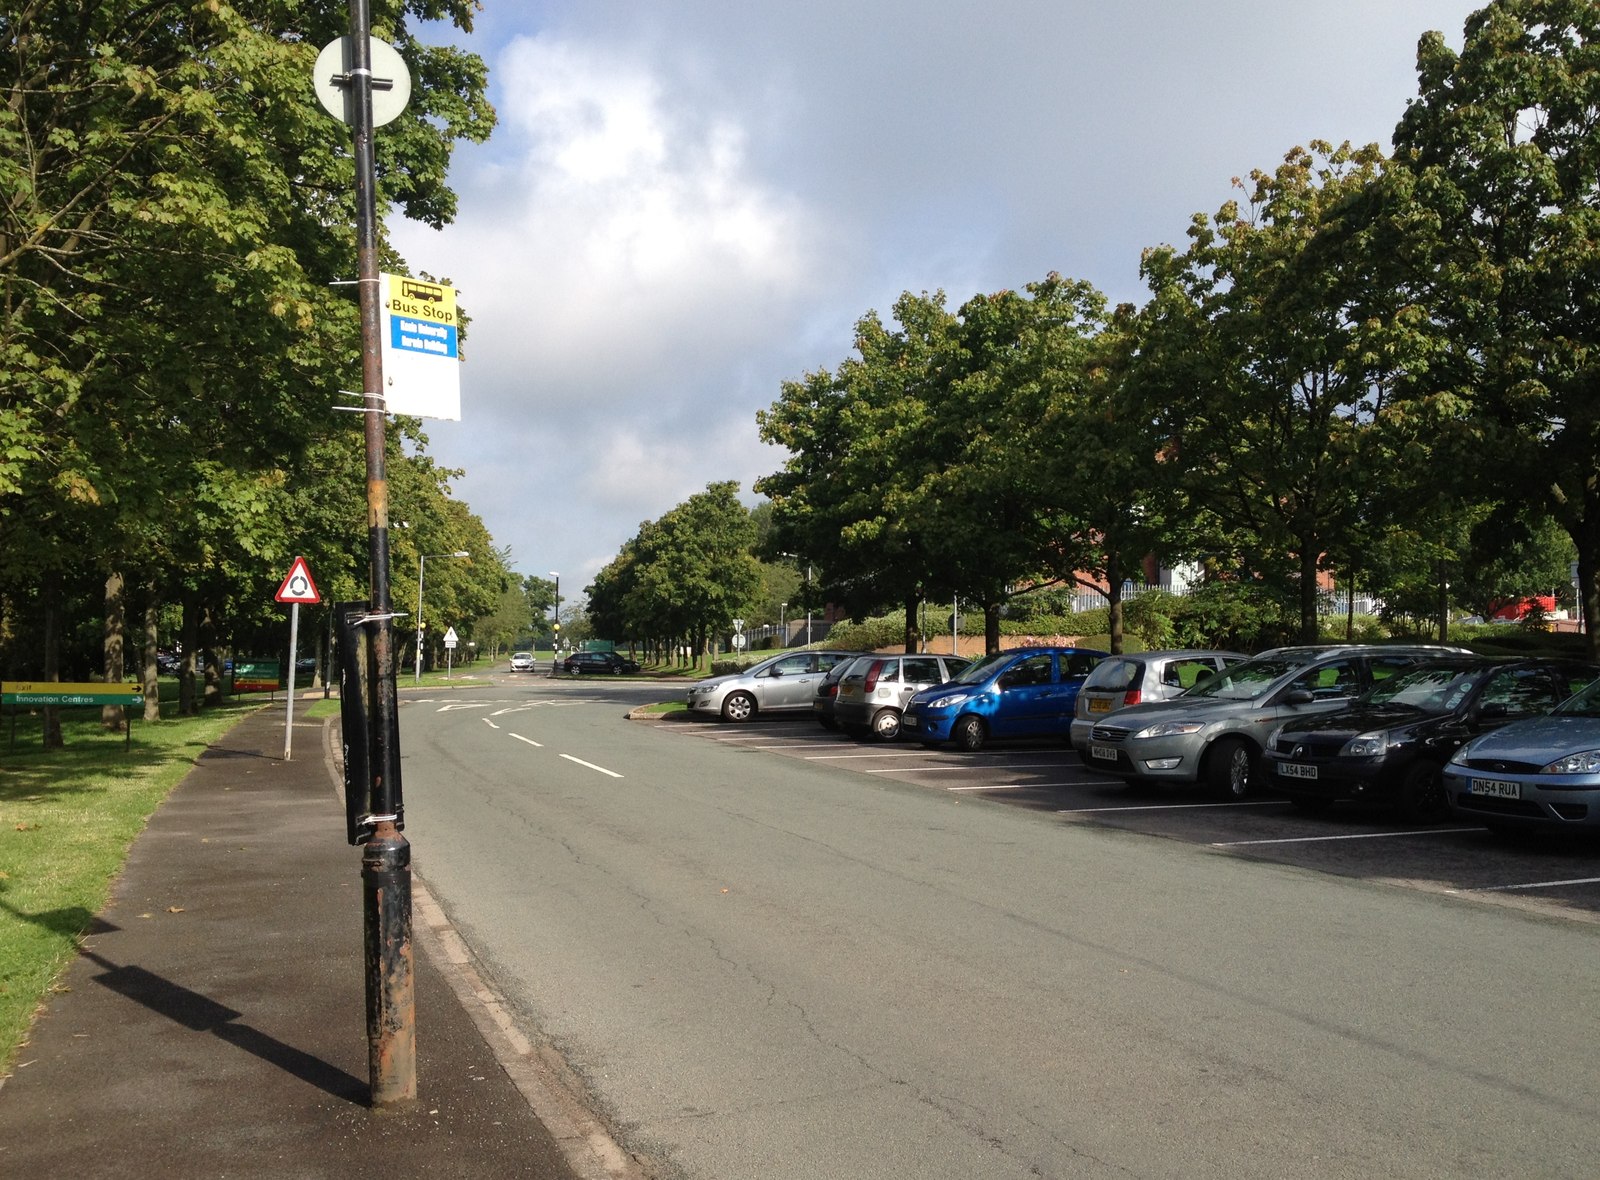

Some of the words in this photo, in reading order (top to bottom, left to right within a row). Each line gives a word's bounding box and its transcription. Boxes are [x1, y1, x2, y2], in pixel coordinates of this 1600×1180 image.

[392, 299, 418, 315] Bus
[423, 305, 453, 323] Stop
[16, 694, 59, 703] Innovation
[61, 695, 94, 703] Centres
[1472, 780, 1497, 794] DN54
[1499, 783, 1518, 797] RUA
